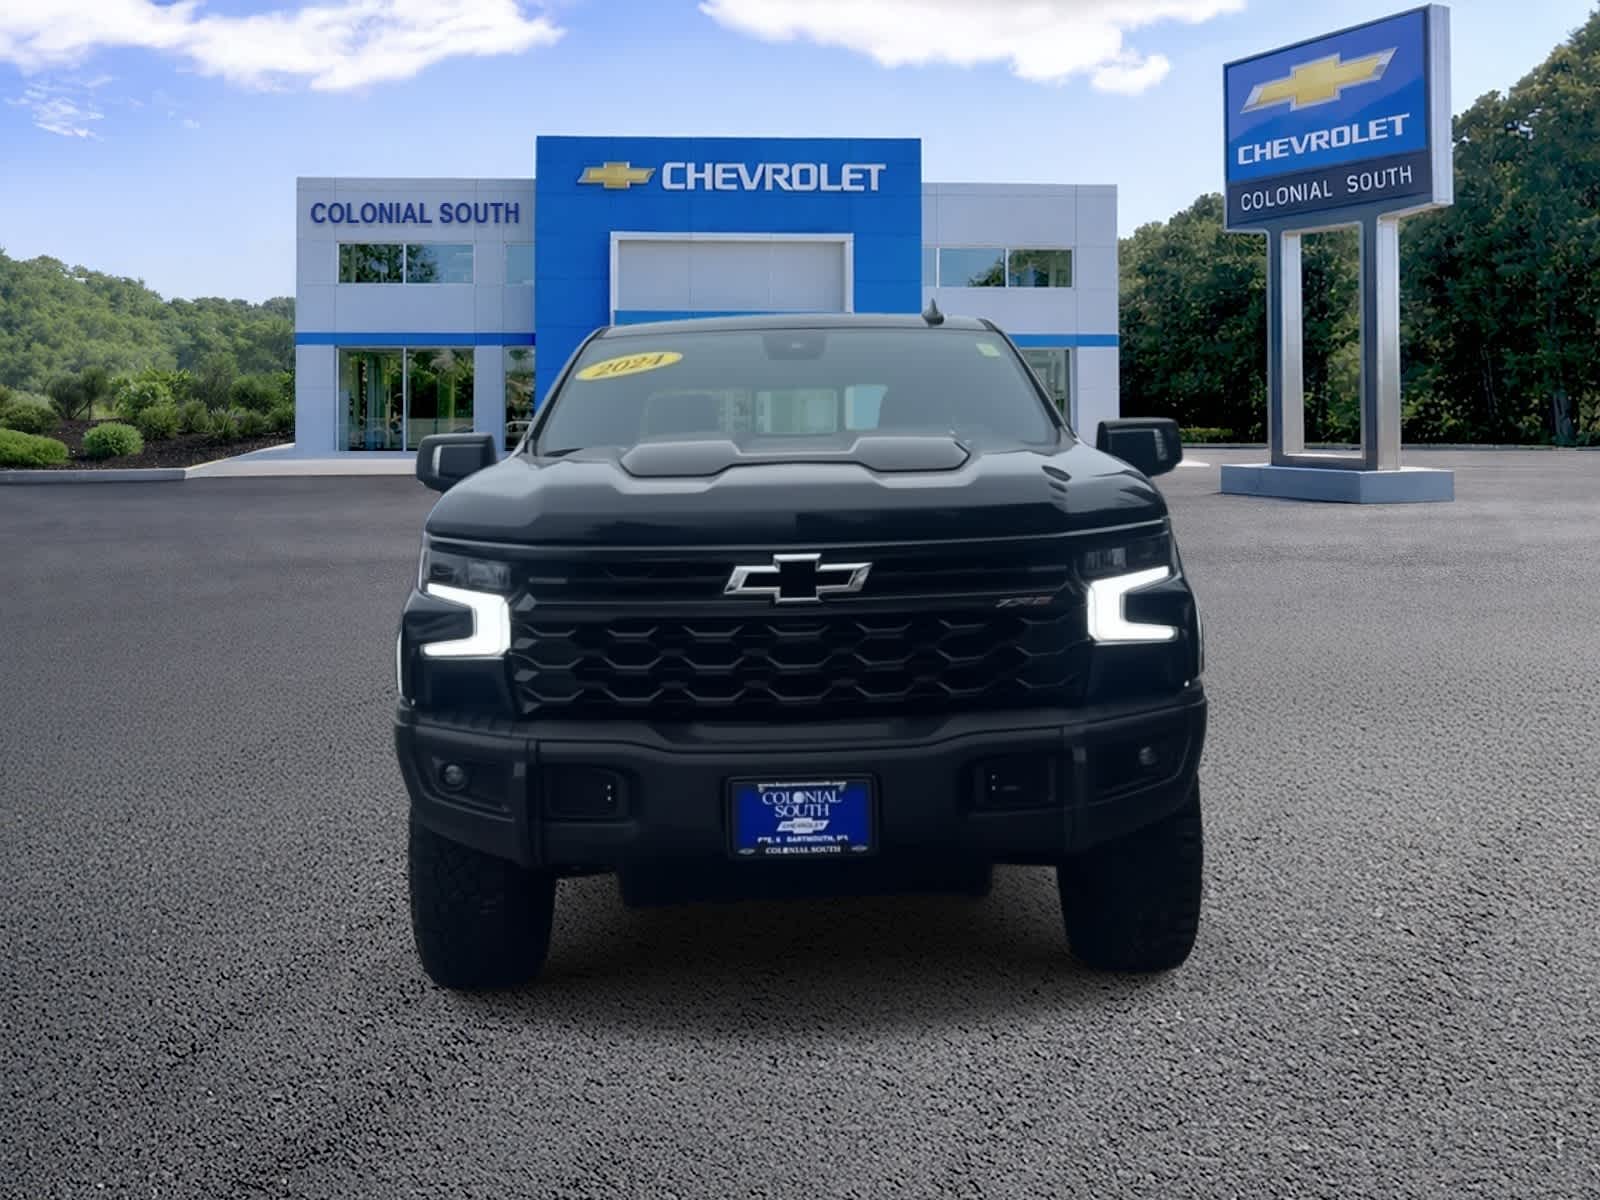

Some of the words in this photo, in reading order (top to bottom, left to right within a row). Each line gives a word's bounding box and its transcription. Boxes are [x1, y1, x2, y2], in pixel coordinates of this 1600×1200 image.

[1238, 114, 1410, 165] CHEVROLET
[662, 162, 887, 192] CHEVROLET
[1241, 180, 1333, 211] COLONIAL
[1346, 165, 1412, 193] SOUTH
[311, 202, 432, 225] COLONIAL
[441, 202, 521, 225] SOUTH
[593, 354, 665, 377] 2024
[762, 790, 842, 805] COLONIAL
[774, 804, 829, 818] SOUTH
